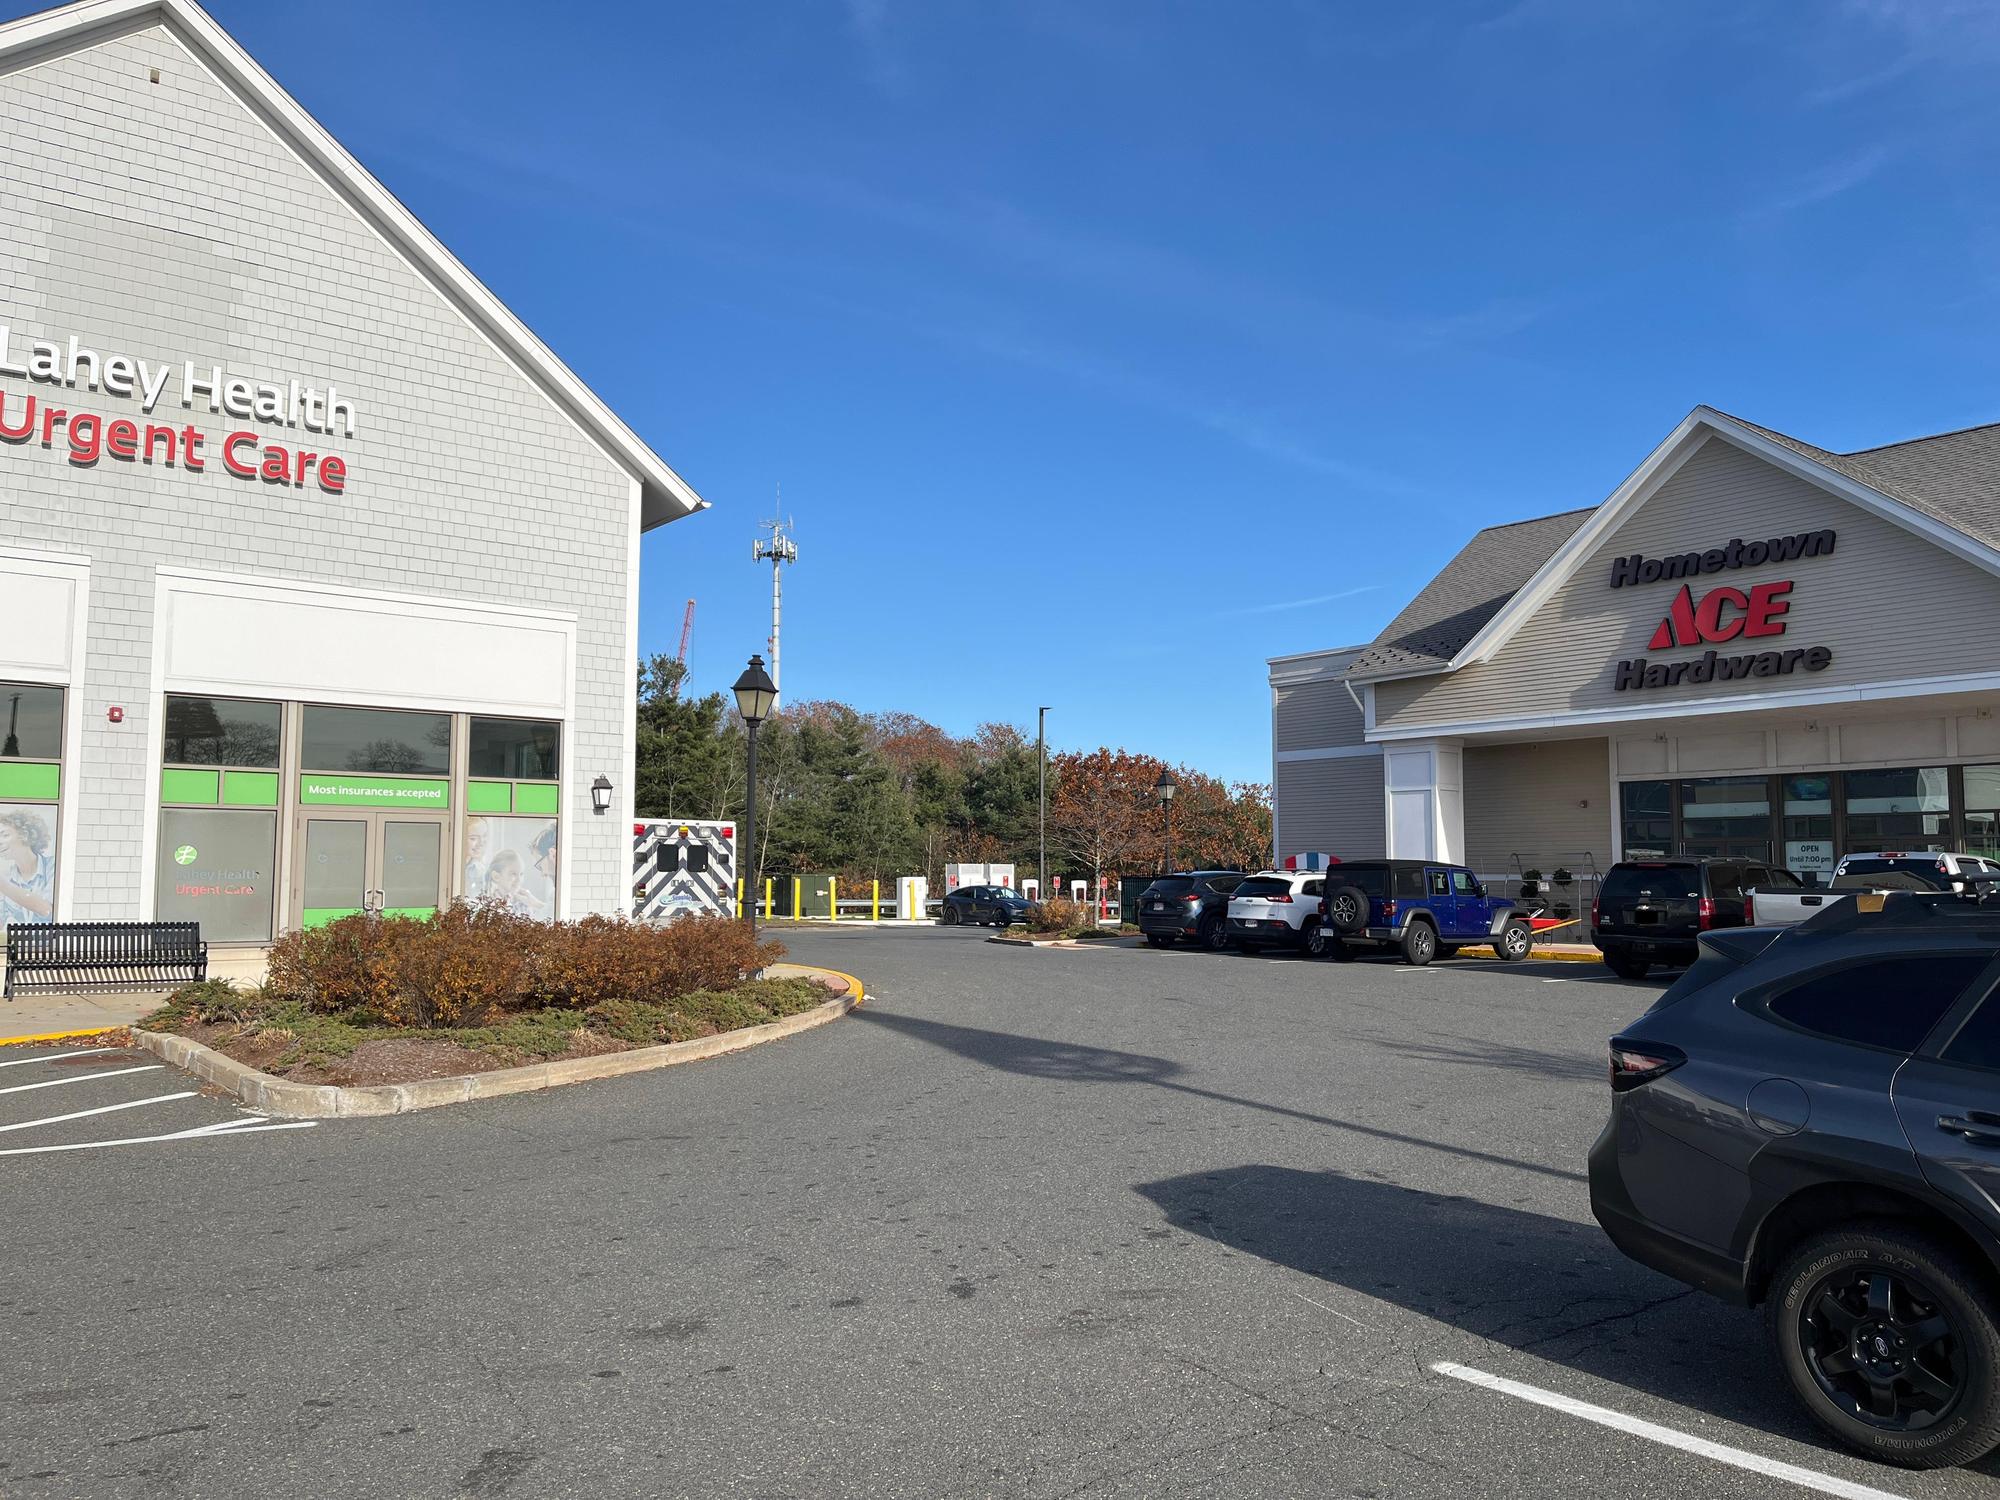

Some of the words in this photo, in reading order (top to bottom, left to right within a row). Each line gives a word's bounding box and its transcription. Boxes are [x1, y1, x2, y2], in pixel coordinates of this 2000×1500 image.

[0, 324, 170, 415] Lahey
[181, 360, 356, 439] Health
[0, 390, 205, 473] Urgent
[222, 431, 347, 495] Care
[1610, 529, 1836, 588] Hometown
[1648, 580, 1794, 650] ACE
[1615, 646, 1832, 691] Hardware
[308, 785, 336, 795] Most
[339, 785, 394, 797] insurances
[396, 788, 441, 799] accepted
[176, 884, 222, 897] Urgent
[1784, 1249, 1870, 1310] GEOLANDAR
[1878, 1252, 1917, 1270] A/T
